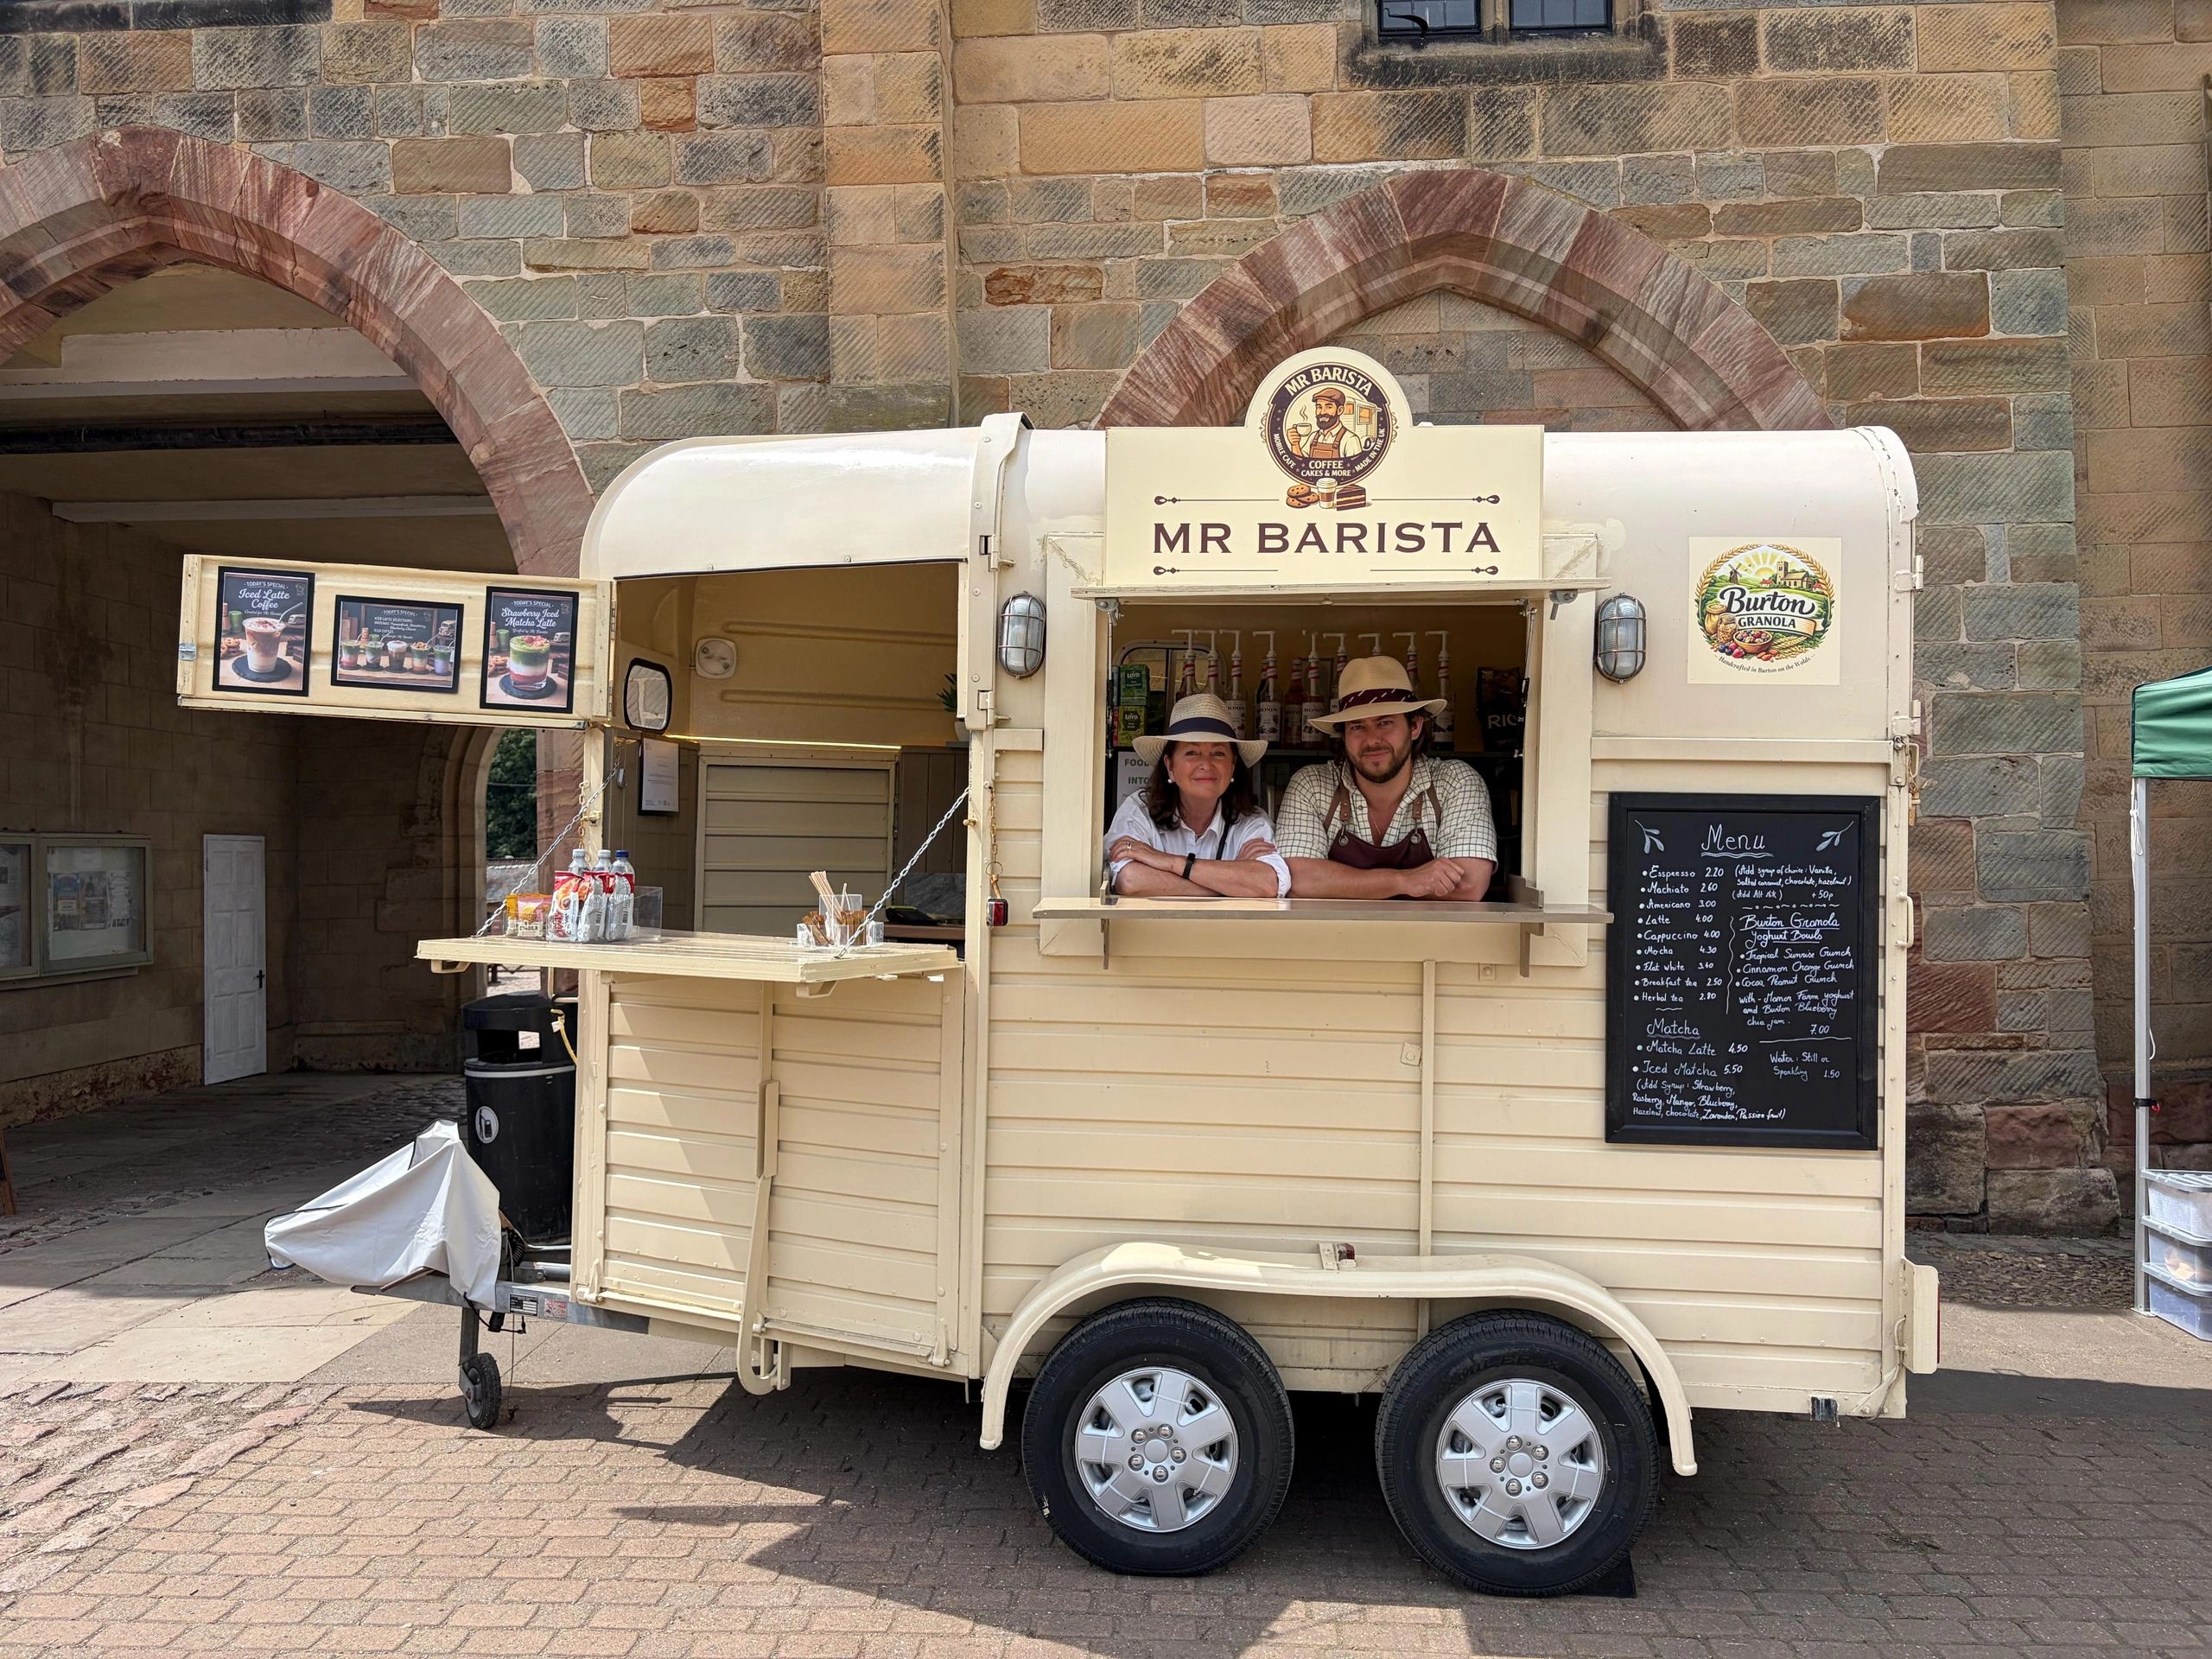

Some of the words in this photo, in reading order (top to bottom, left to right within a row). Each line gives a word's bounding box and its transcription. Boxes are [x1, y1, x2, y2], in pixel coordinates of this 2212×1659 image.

[1284, 373, 1311, 397] MR
[1310, 366, 1373, 397] BARISTA
[1379, 428, 1385, 438] UK
[1273, 433, 1284, 456] MOBILE
[1282, 454, 1296, 469] CAFE
[1375, 440, 1384, 452] THE
[1370, 451, 1377, 461] IN
[1308, 460, 1344, 469] COFFEE
[1354, 458, 1370, 472] MADE
[1154, 523, 1232, 554] MR
[1256, 521, 1501, 554] BARISTA
[238, 588, 262, 599] Iced
[263, 589, 290, 601] Latte
[1719, 587, 1815, 615] Burton
[251, 599, 278, 611] Coffee
[501, 607, 541, 620] Strawberry
[542, 608, 560, 618] Iced
[505, 617, 536, 627] Matcha
[536, 618, 556, 629] Latte
[1738, 616, 1796, 629] GRANOLA
[1719, 656, 1751, 671] Handcrafted
[1795, 657, 1811, 667] Wolds
[1700, 823, 1765, 851] Menu
[1649, 865, 1696, 881] Esspresso
[1735, 864, 1754, 877] (Add
[1758, 867, 1775, 878] syrup
[1776, 865, 1785, 875] of
[1647, 881, 1689, 894] Machiato
[1732, 889, 1751, 900] (Add
[1646, 899, 1691, 909] Americano
[1645, 914, 1671, 925] Latte
[1695, 913, 1713, 923] 4.00
[1739, 914, 1784, 931] Burton
[1789, 912, 1840, 929] Granola
[1643, 930, 1699, 944] Cappuccino
[1703, 930, 1721, 939] 4.00
[1790, 928, 1823, 942] Bowls
[1644, 945, 1674, 955] Mocha
[1699, 945, 1718, 954] 4.30
[1745, 948, 1779, 964] Tropical
[1783, 948, 1815, 960] Sunrise
[1819, 946, 1852, 958] Crunch
[1643, 960, 1660, 972] Flat
[1663, 960, 1685, 971] white
[1742, 963, 1789, 975] Cinnamon
[1791, 960, 1821, 978] Orange
[1823, 957, 1854, 971] Crunch
[1641, 976, 1681, 988] Breakfast
[1684, 977, 1698, 988] tea
[1706, 977, 1723, 987] 2.50
[1767, 974, 1798, 987] Peanut
[1804, 971, 1838, 984] Crunch
[1642, 991, 1667, 1002] Herbal
[1670, 993, 1684, 1002] tea
[1698, 992, 1717, 1001] 2.80
[1738, 992, 1757, 1004] with
[1764, 990, 1793, 1003] Manor
[1796, 989, 1819, 1001] Farm
[1821, 988, 1854, 1007] yoghurt
[1743, 1005, 1758, 1014] and
[1763, 1004, 1791, 1014] Burton
[1795, 1001, 1838, 1020] Blueberry
[1646, 1017, 1700, 1036] Matcha
[1746, 1015, 1765, 1027] chia
[1809, 1024, 1830, 1035] 7.00
[1646, 1039, 1683, 1055] Matcha
[1688, 1042, 1717, 1056] Latte
[1728, 1042, 1749, 1054] 4.50
[1802, 1052, 1818, 1063] Still
[1642, 1059, 1668, 1074] Iced
[1674, 1062, 1718, 1077] Matcha
[1723, 1064, 1744, 1075] 5.50
[1773, 1065, 1808, 1082] Sparkling
[1823, 1069, 1840, 1078] 1.50
[1637, 1077, 1658, 1091] (Add
[1692, 1079, 1735, 1098] Strawberry,
[1666, 1093, 1696, 1111] Mango,
[1697, 1094, 1738, 1111] Blueberry,
[1736, 1108, 1764, 1120] Passion
